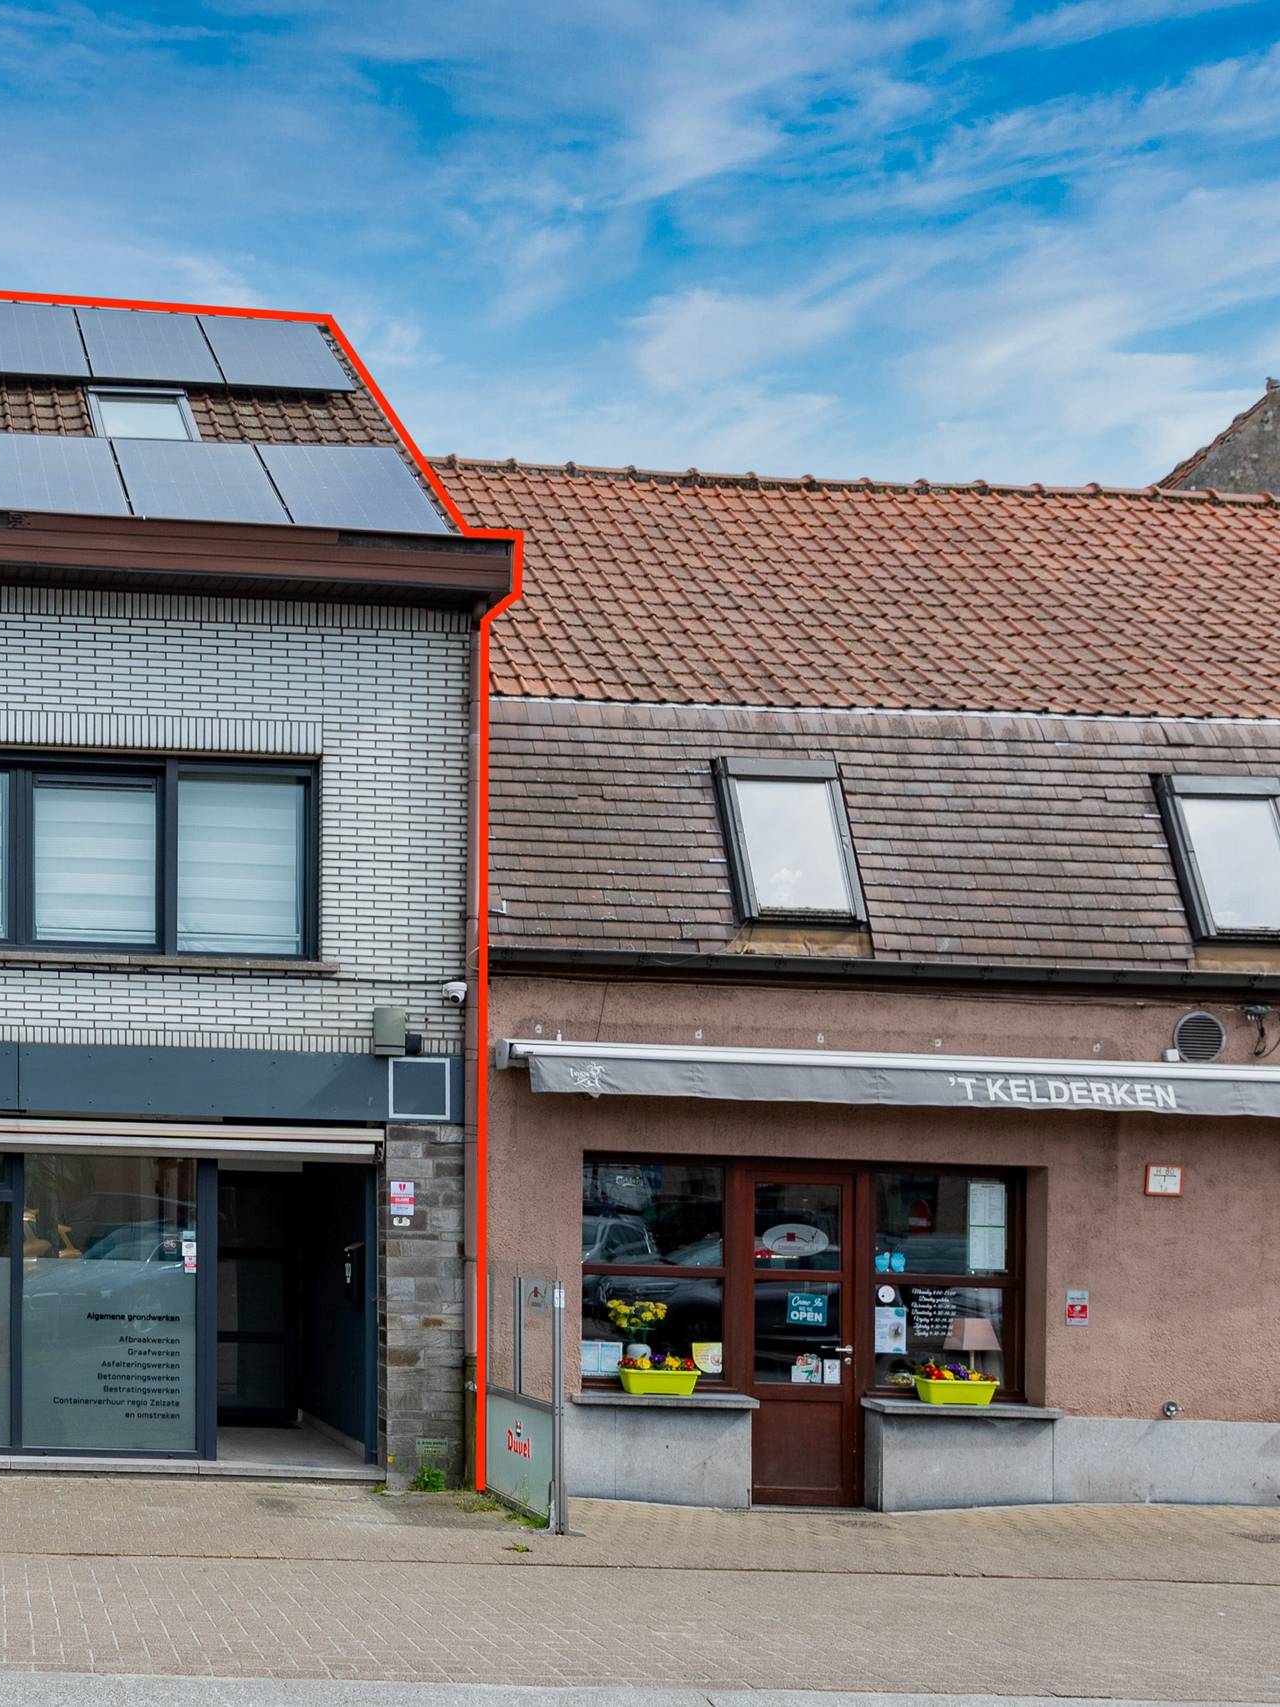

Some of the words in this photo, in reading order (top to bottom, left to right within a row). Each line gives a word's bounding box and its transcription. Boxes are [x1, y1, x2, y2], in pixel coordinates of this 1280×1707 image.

[986, 1078, 1177, 1107] KELDERKEN
[791, 1296, 811, 1306] Come
[86, 1312, 125, 1322] Algemene
[127, 1313, 180, 1322] grondwerken
[791, 1310, 823, 1322] OPEN
[119, 1336, 180, 1345] Afbraakwerken
[127, 1348, 180, 1357] Graafwerken
[101, 1360, 180, 1370] Asfalteringswerken
[97, 1372, 180, 1383] Betonneringswerken
[103, 1385, 180, 1395] Bestratingswerken
[53, 1396, 124, 1406] Containerverhuur
[127, 1399, 148, 1408] regio
[150, 1399, 180, 1408] Zelzate
[125, 1411, 135, 1419] en
[137, 1411, 180, 1419] omstreken
[507, 1429, 530, 1458] Duvel
